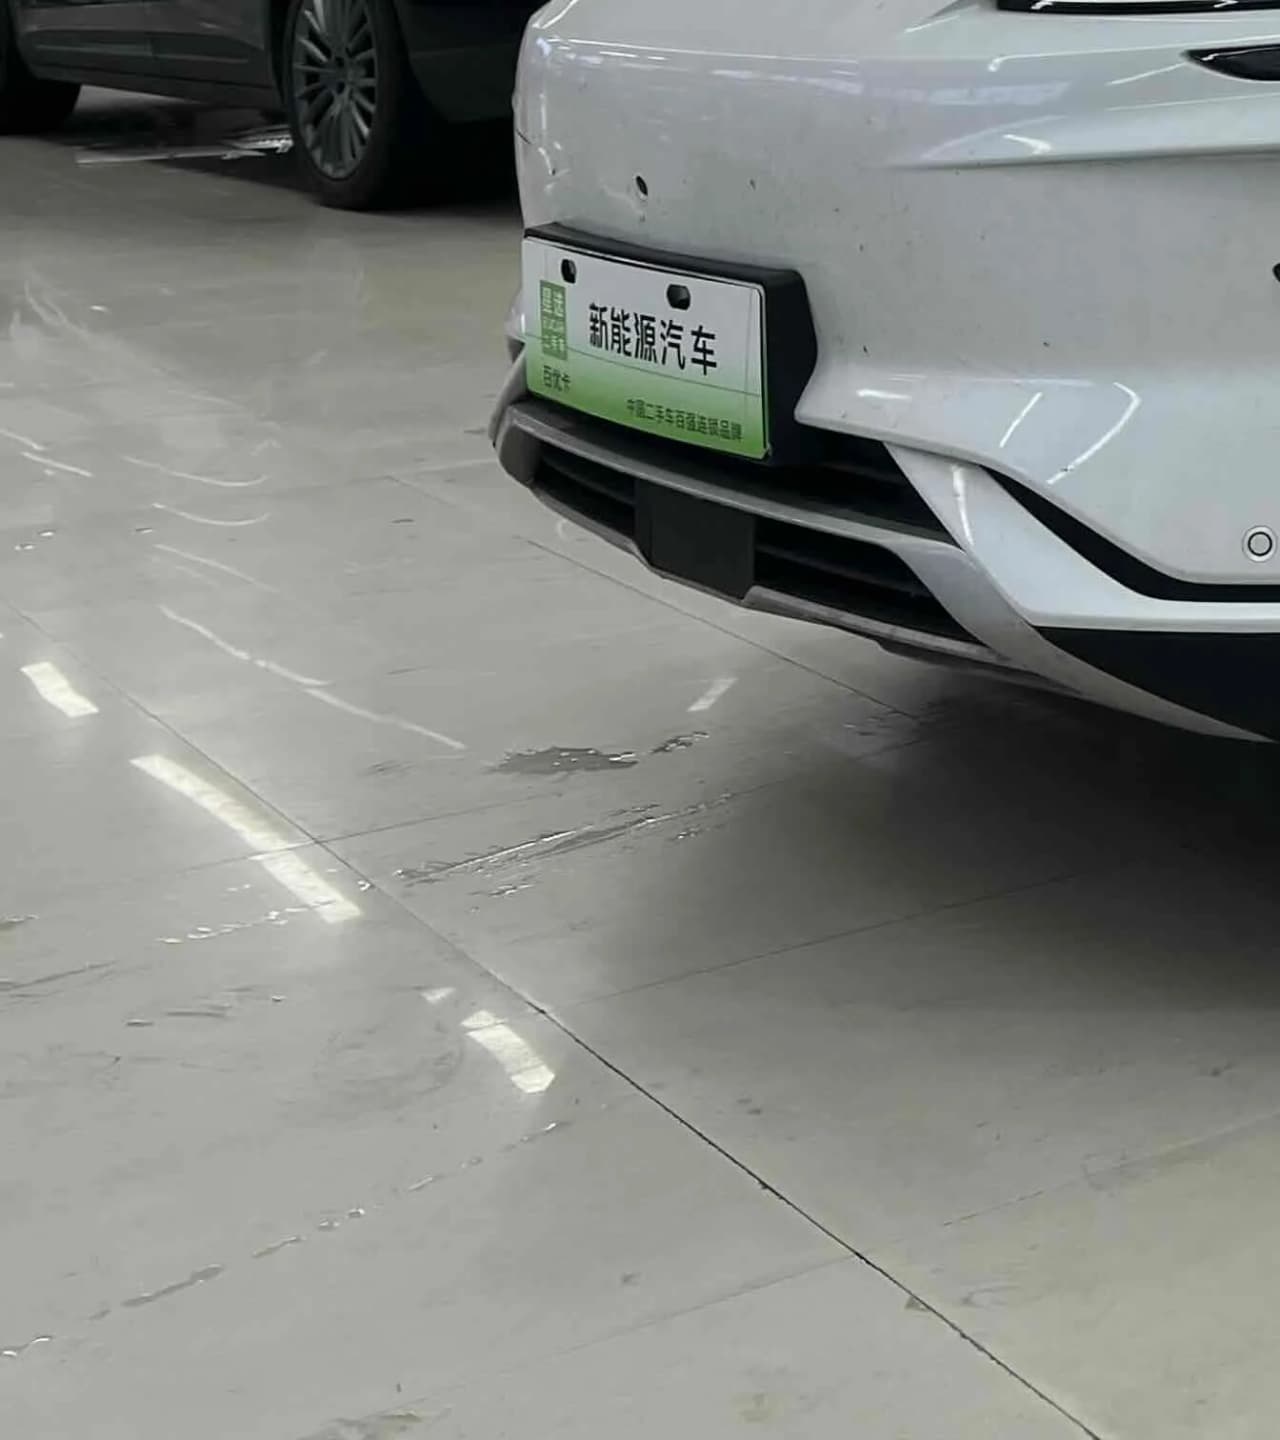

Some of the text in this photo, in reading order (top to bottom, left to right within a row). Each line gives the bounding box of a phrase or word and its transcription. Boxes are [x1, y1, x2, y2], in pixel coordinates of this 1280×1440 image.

[588, 303, 718, 376] 新能源汽车
